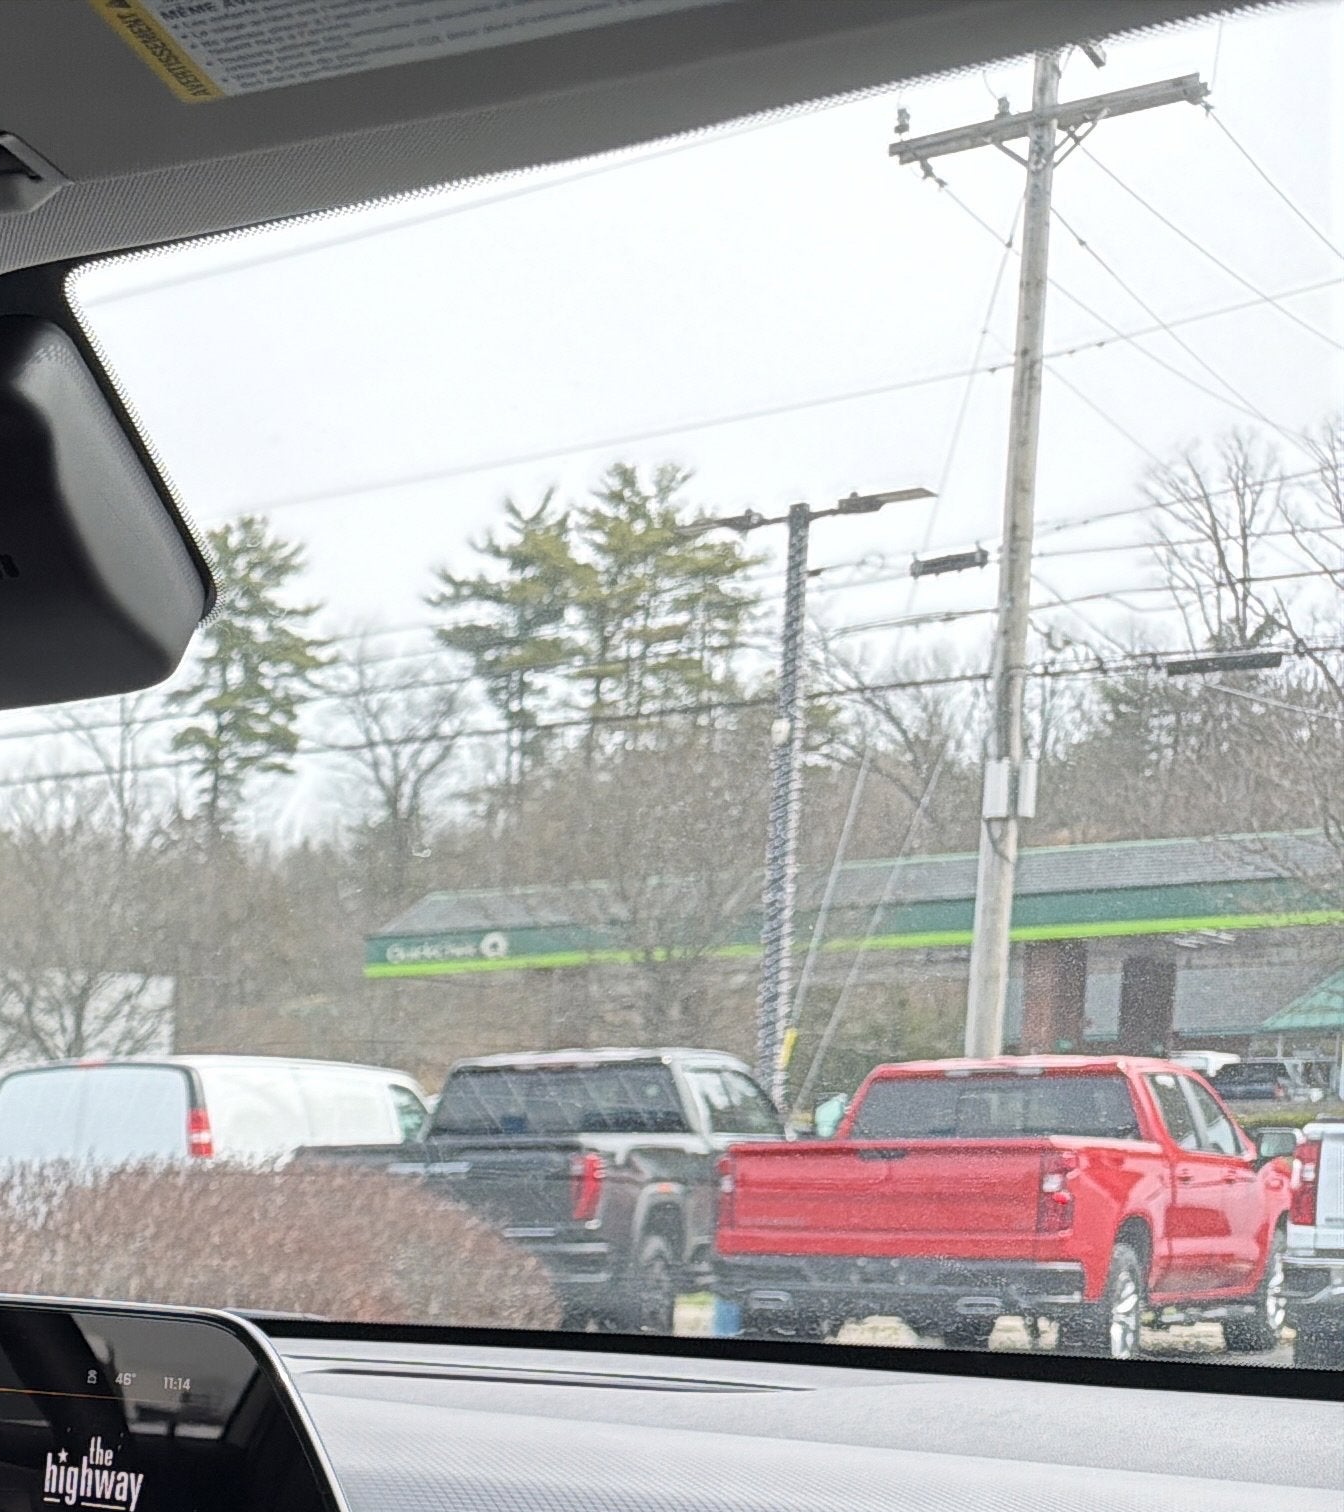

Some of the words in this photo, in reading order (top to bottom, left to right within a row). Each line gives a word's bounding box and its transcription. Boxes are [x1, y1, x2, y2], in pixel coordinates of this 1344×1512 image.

[117, 13, 211, 97] AVERTISSEMENT
[115, 1372, 137, 1386] 46°
[163, 1376, 191, 1391] 11:14
[89, 1436, 113, 1466] the
[43, 1448, 144, 1512] highway
